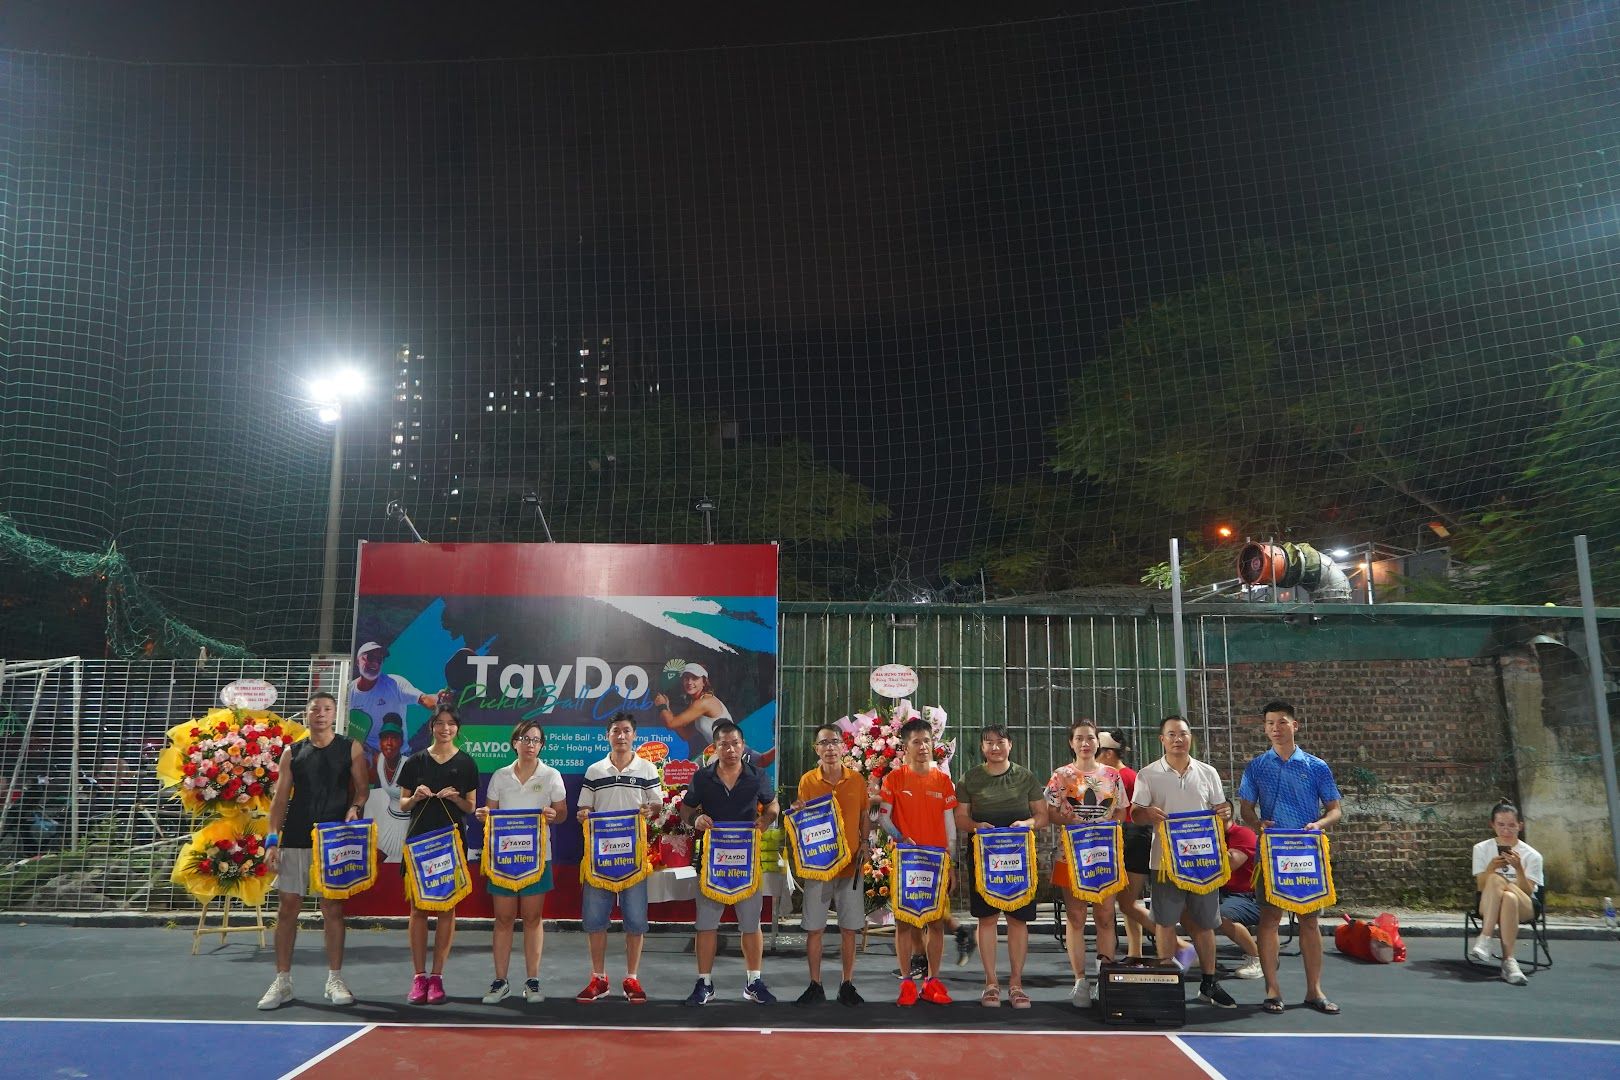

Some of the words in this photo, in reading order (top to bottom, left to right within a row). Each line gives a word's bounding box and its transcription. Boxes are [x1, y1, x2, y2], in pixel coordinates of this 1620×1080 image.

[467, 656, 648, 714] TayDo
[522, 684, 590, 720] Ball
[592, 684, 654, 720] Club
[465, 742, 511, 753] TAYDO
[567, 744, 592, 753] Hoàng
[811, 828, 830, 838] TAYDO
